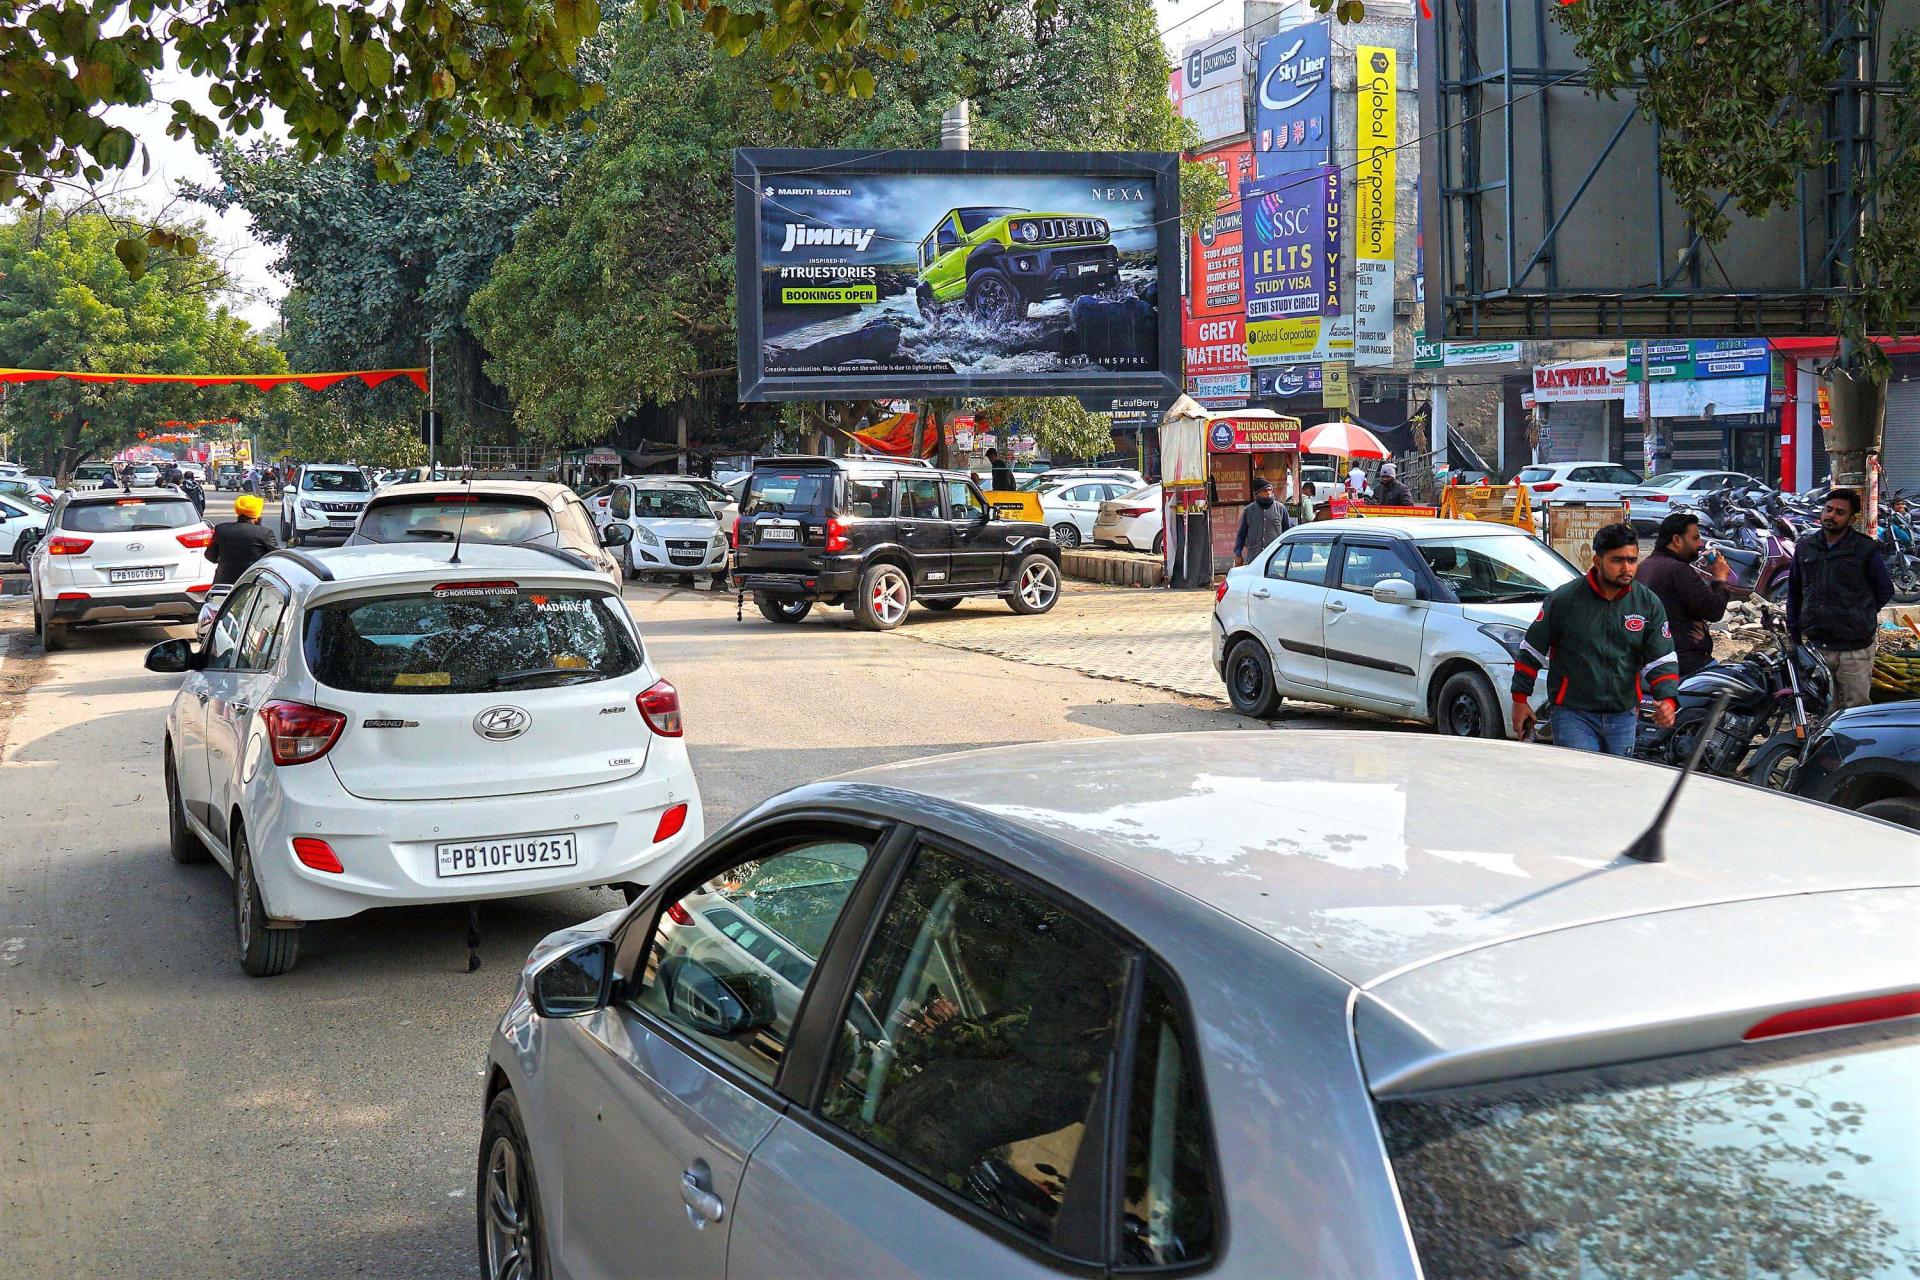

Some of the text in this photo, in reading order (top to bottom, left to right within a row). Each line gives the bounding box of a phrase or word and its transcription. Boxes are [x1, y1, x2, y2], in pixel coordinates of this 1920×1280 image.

[1278, 63, 1298, 82] Sky
[1300, 57, 1326, 75] Liner
[1366, 77, 1388, 253] Global Corporation
[778, 188, 852, 196] MARUTI SUZUKI
[1092, 188, 1144, 201] NEXA
[1327, 174, 1338, 242] STUDY
[1273, 207, 1309, 239] SSC
[780, 223, 876, 252] Jimny
[1203, 248, 1221, 260] STUDY
[1253, 243, 1313, 275] IELTS
[780, 266, 876, 278] #TRUESTORIES
[1359, 263, 1386, 272] STUDY VISA
[1227, 269, 1240, 279] VISA
[1327, 252, 1338, 306] VISA
[1227, 281, 1240, 291] VISA
[1254, 275, 1312, 295] STUDY VISA
[1359, 277, 1373, 286] IELTS
[786, 290, 873, 300] BOOKINGS OPEN
[1359, 290, 1369, 299] PTE
[1249, 296, 1318, 315] SETHI STUDY CIRCLE
[1359, 304, 1376, 313] CELPIP
[1359, 318, 1366, 327] PR
[1199, 319, 1238, 342] GREY
[1256, 327, 1317, 344] Global Corporation
[1359, 331, 1386, 341] TOURIST VISA
[1187, 342, 1249, 366] MATTERS
[1358, 345, 1392, 355] TOUR PACKAGES
[1416, 340, 1437, 358] siec
[1535, 367, 1611, 389] EATWELL
[1199, 384, 1237, 396] PTE CENTRE
[1118, 399, 1159, 409] LeafBerry
[1750, 409, 1776, 425] ATM
[1236, 421, 1298, 431] BUILDING OWNERS
[1475, 489, 1489, 497] POLICE
[1566, 528, 1587, 538] ENTRY
[450, 588, 518, 597] NORTHERN HYUNDAI
[364, 720, 402, 728] GRAND
[452, 840, 573, 870] PB10FU9251
